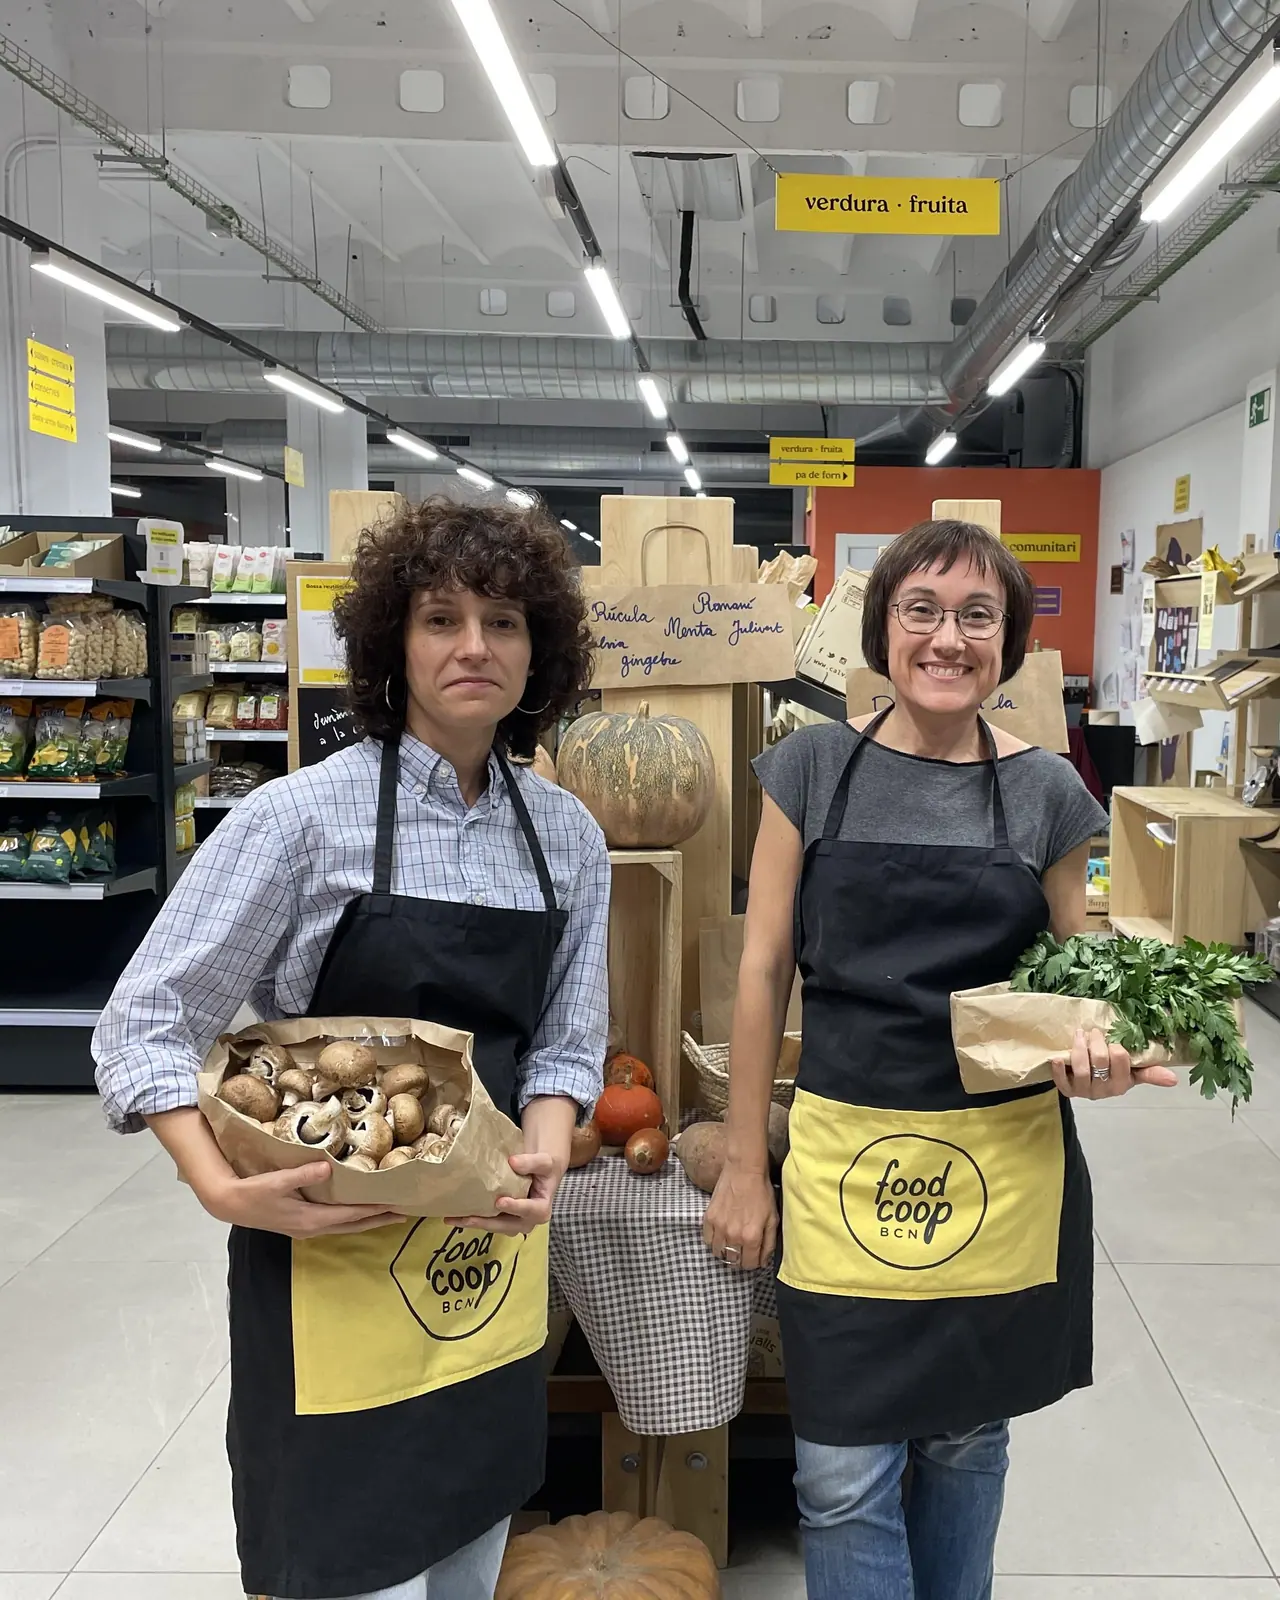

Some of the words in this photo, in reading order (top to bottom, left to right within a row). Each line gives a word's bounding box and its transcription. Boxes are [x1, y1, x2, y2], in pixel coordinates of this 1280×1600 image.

[805, 194, 889, 213] verdura
[909, 195, 968, 213] fruita
[781, 445, 813, 453] verdura
[820, 445, 843, 453] fruita
[795, 472, 807, 480] pa
[808, 471, 820, 479] de
[822, 471, 841, 479] forn
[1009, 541, 1077, 553] comunitari
[591, 601, 655, 623] Rúcula
[692, 592, 757, 615] Romaní
[664, 617, 717, 640] Menta
[728, 620, 785, 647] Julivert
[621, 651, 683, 678] gingebre
[813, 659, 847, 680] www.calv
[992, 693, 1018, 711] la
[874, 1158, 953, 1205] food
[876, 1199, 953, 1245] coop
[880, 1226, 918, 1240] BCN
[431, 1259, 502, 1310] coop
[442, 1297, 475, 1314] BCN
